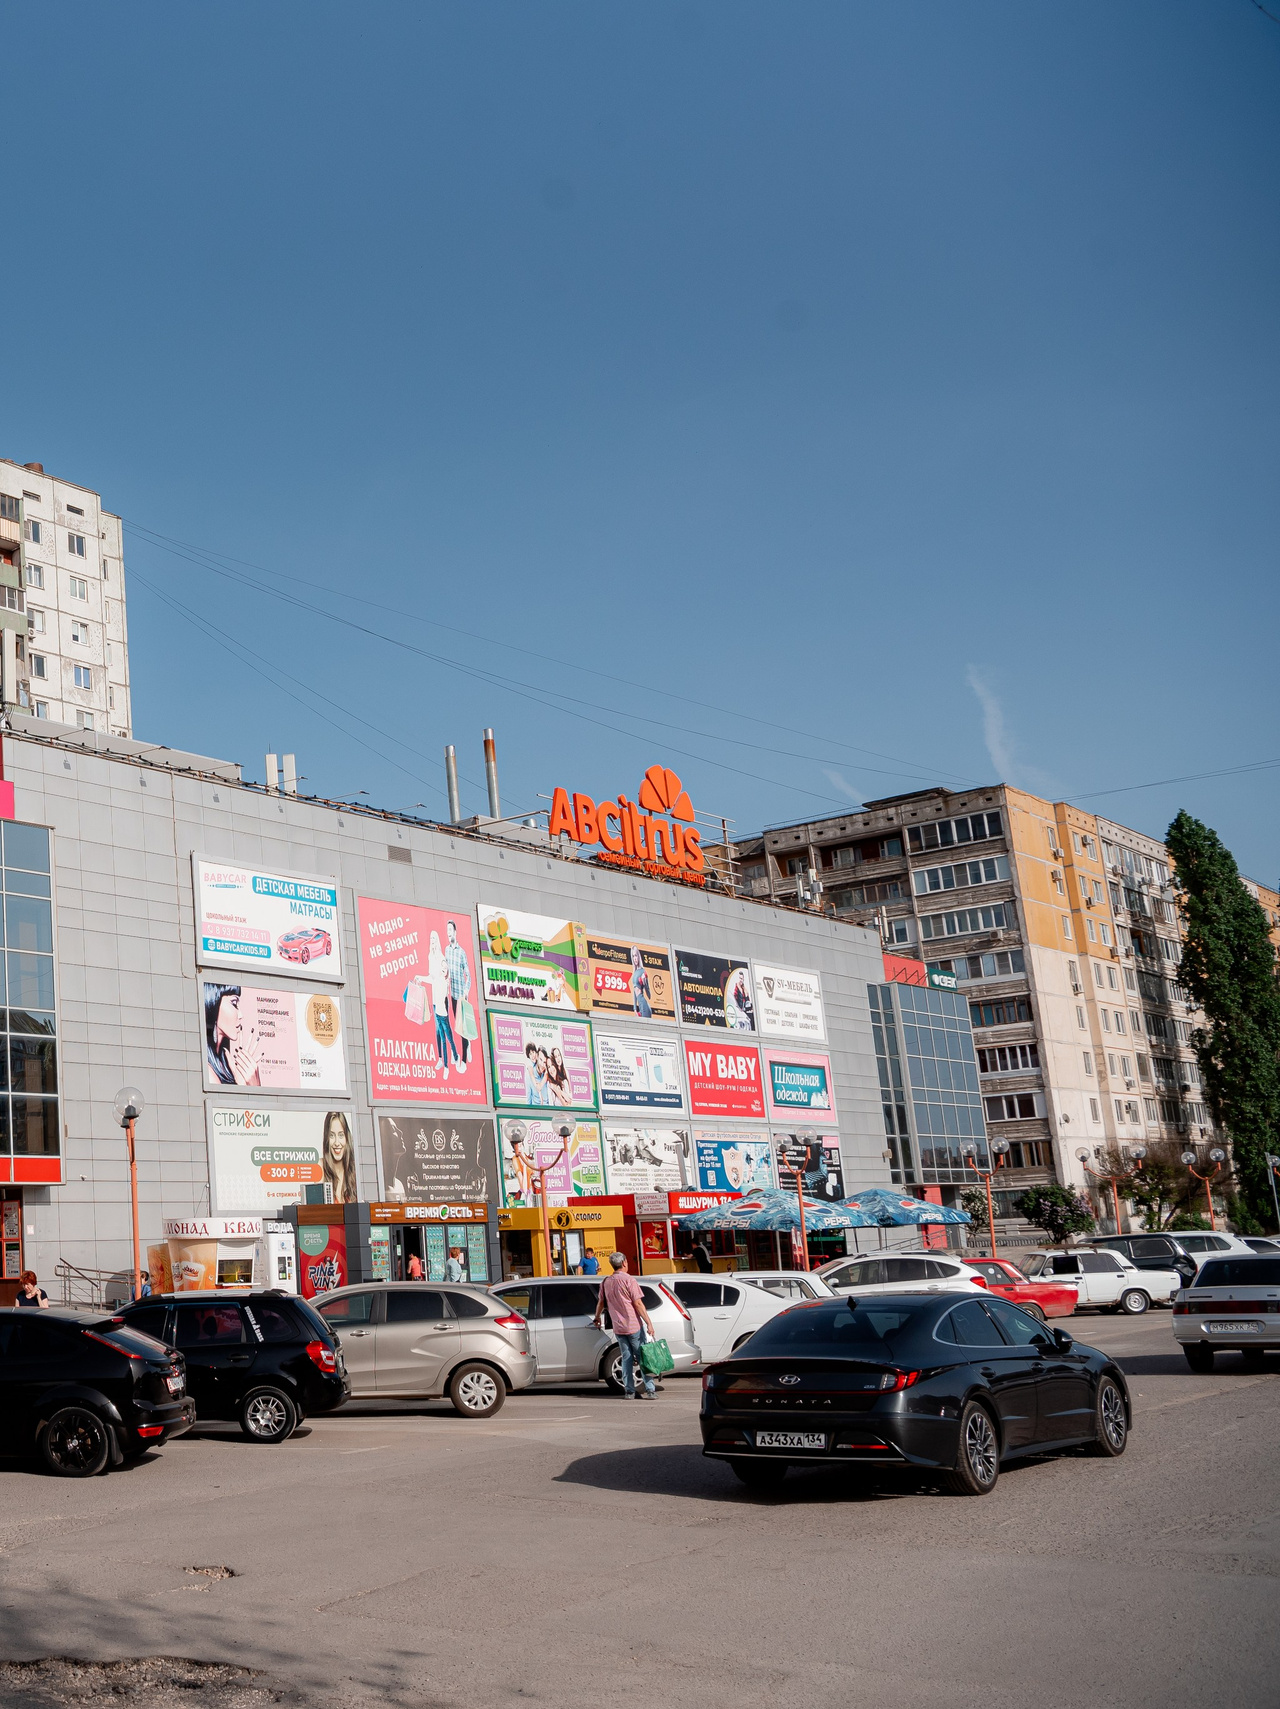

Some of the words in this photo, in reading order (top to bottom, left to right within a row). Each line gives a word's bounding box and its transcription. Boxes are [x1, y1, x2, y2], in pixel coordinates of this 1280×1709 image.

[549, 787, 705, 872] ABCitrus
[204, 873, 247, 884] BABYCAR
[682, 871, 707, 888] центр
[256, 878, 295, 897] ДЕТСКАЯ
[297, 885, 332, 903] МЕБЕЛЬ
[290, 901, 333, 920] МАТРАСЫ
[368, 919, 405, 938] Модно
[216, 941, 268, 956] BABYCARKIDS.RU
[369, 944, 384, 958] не
[385, 932, 419, 954] значит
[380, 950, 419, 978] дорого!
[487, 967, 518, 984] ЦЕНТР
[596, 974, 603, 987] 3
[489, 983, 507, 997] ДЛЯ
[683, 982, 723, 997] АВТОШКОЛА
[777, 979, 813, 993] SV-МЕБЕЛЬ
[498, 1026, 520, 1037] ПОДАРКИ
[374, 1038, 436, 1061] ГАЛАКТИКА
[377, 1061, 411, 1078] ОДЕЖДА
[412, 1064, 437, 1079] ОБУВЬ
[688, 1051, 712, 1077] MY
[716, 1054, 756, 1081] BABY
[502, 1070, 522, 1080] ПОСУДА
[774, 1066, 820, 1087] Школьная
[573, 1085, 588, 1094] ДЕКОР
[694, 1081, 715, 1090] ДЕТСКИЙ
[739, 1085, 758, 1093] ОДЕЖДА
[776, 1084, 808, 1102] одежда
[254, 1150, 271, 1161] ВСЕ
[273, 1150, 316, 1161] СТРИЖКИ
[267, 1168, 287, 1178] -300
[405, 1206, 440, 1218] ВРЕМЯ
[448, 1206, 473, 1218] ЕСТЬ
[922, 1213, 942, 1221] PEPSI
[223, 1221, 261, 1234] КВАС
[267, 1222, 295, 1233] ВОДА
[713, 1219, 751, 1228] PEPSI
[824, 1216, 851, 1226] PEPSI
[760, 1433, 803, 1447] А343ХА
[805, 1433, 822, 1443] 134
